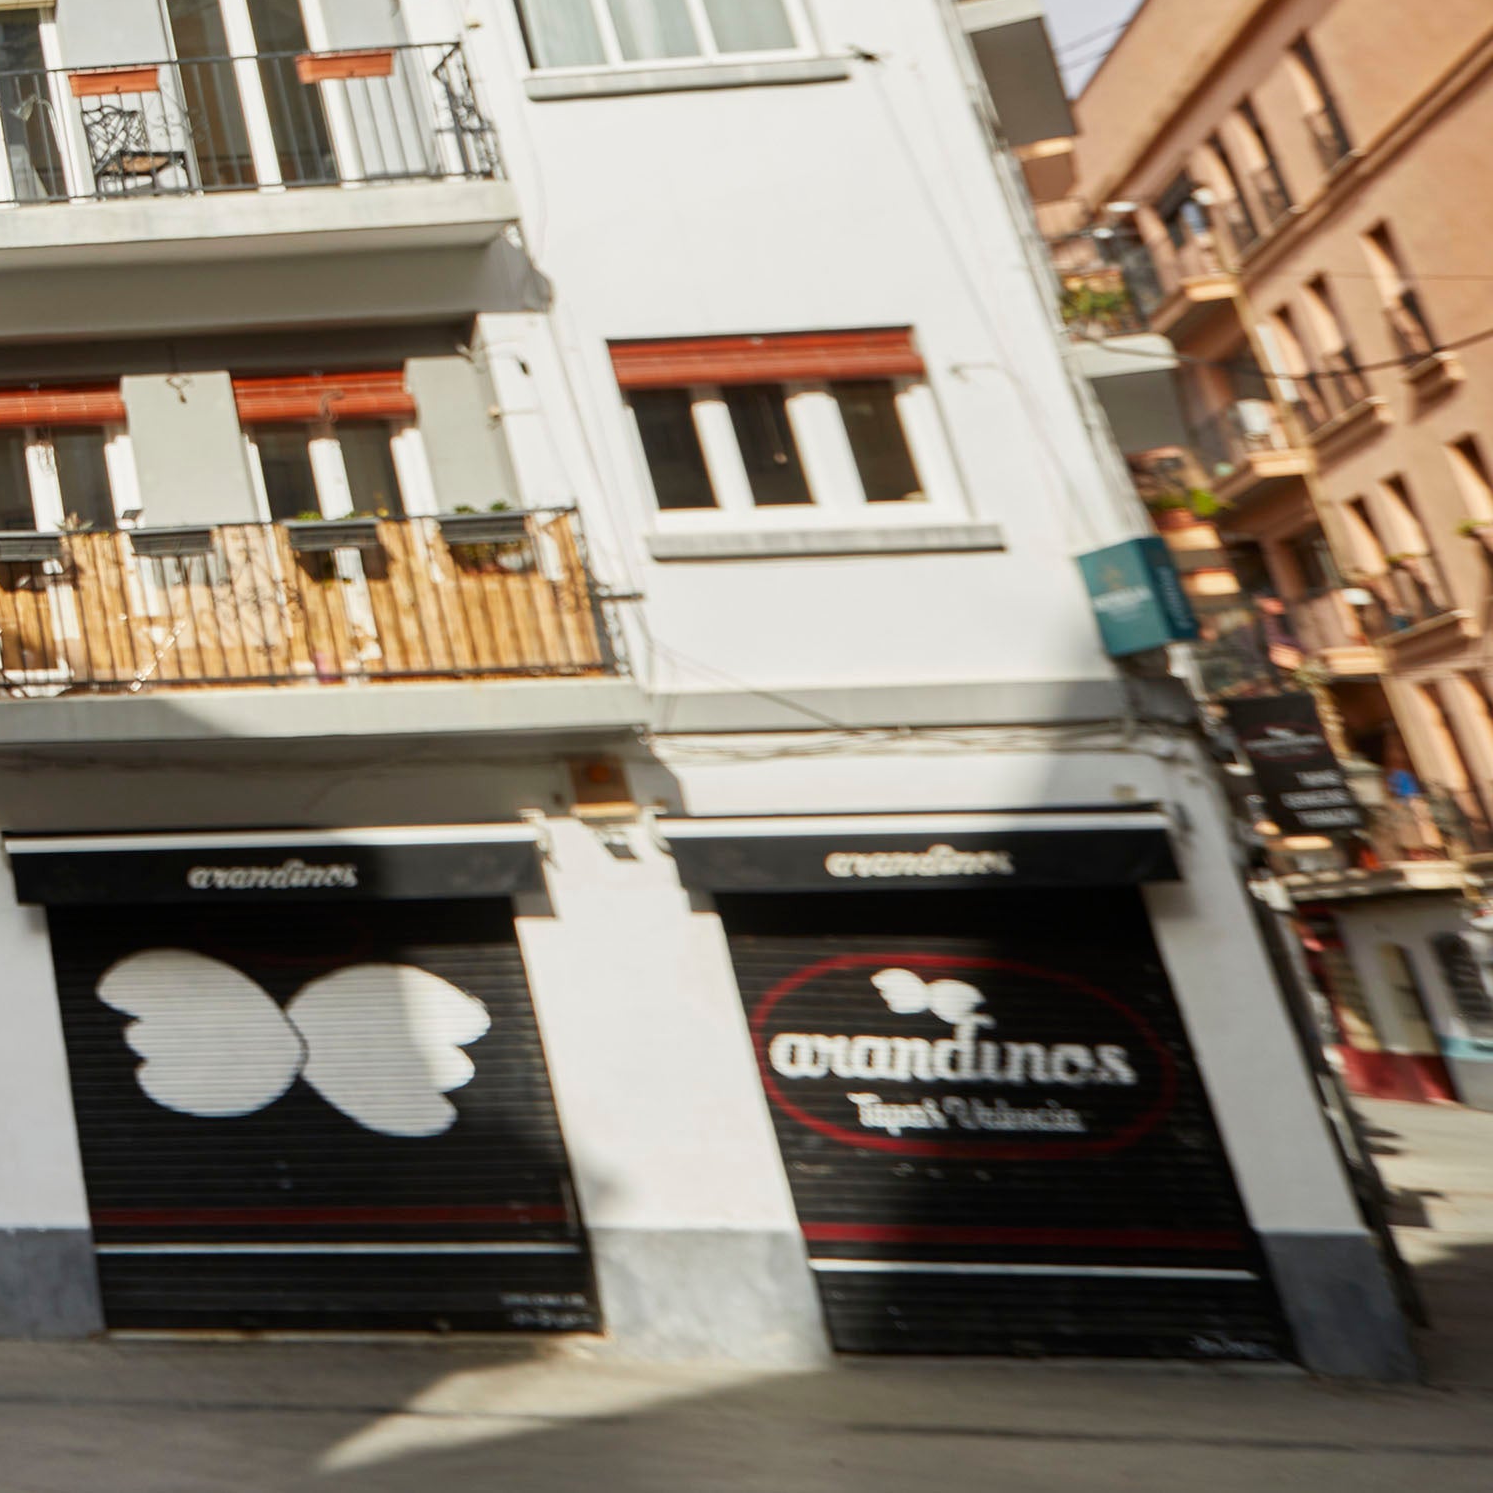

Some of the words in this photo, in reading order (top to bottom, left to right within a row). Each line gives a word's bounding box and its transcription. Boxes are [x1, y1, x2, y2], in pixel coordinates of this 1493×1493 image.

[187, 858, 358, 890] arandinos
[824, 843, 1016, 878] arandinos
[769, 1020, 1137, 1086] arandinos
